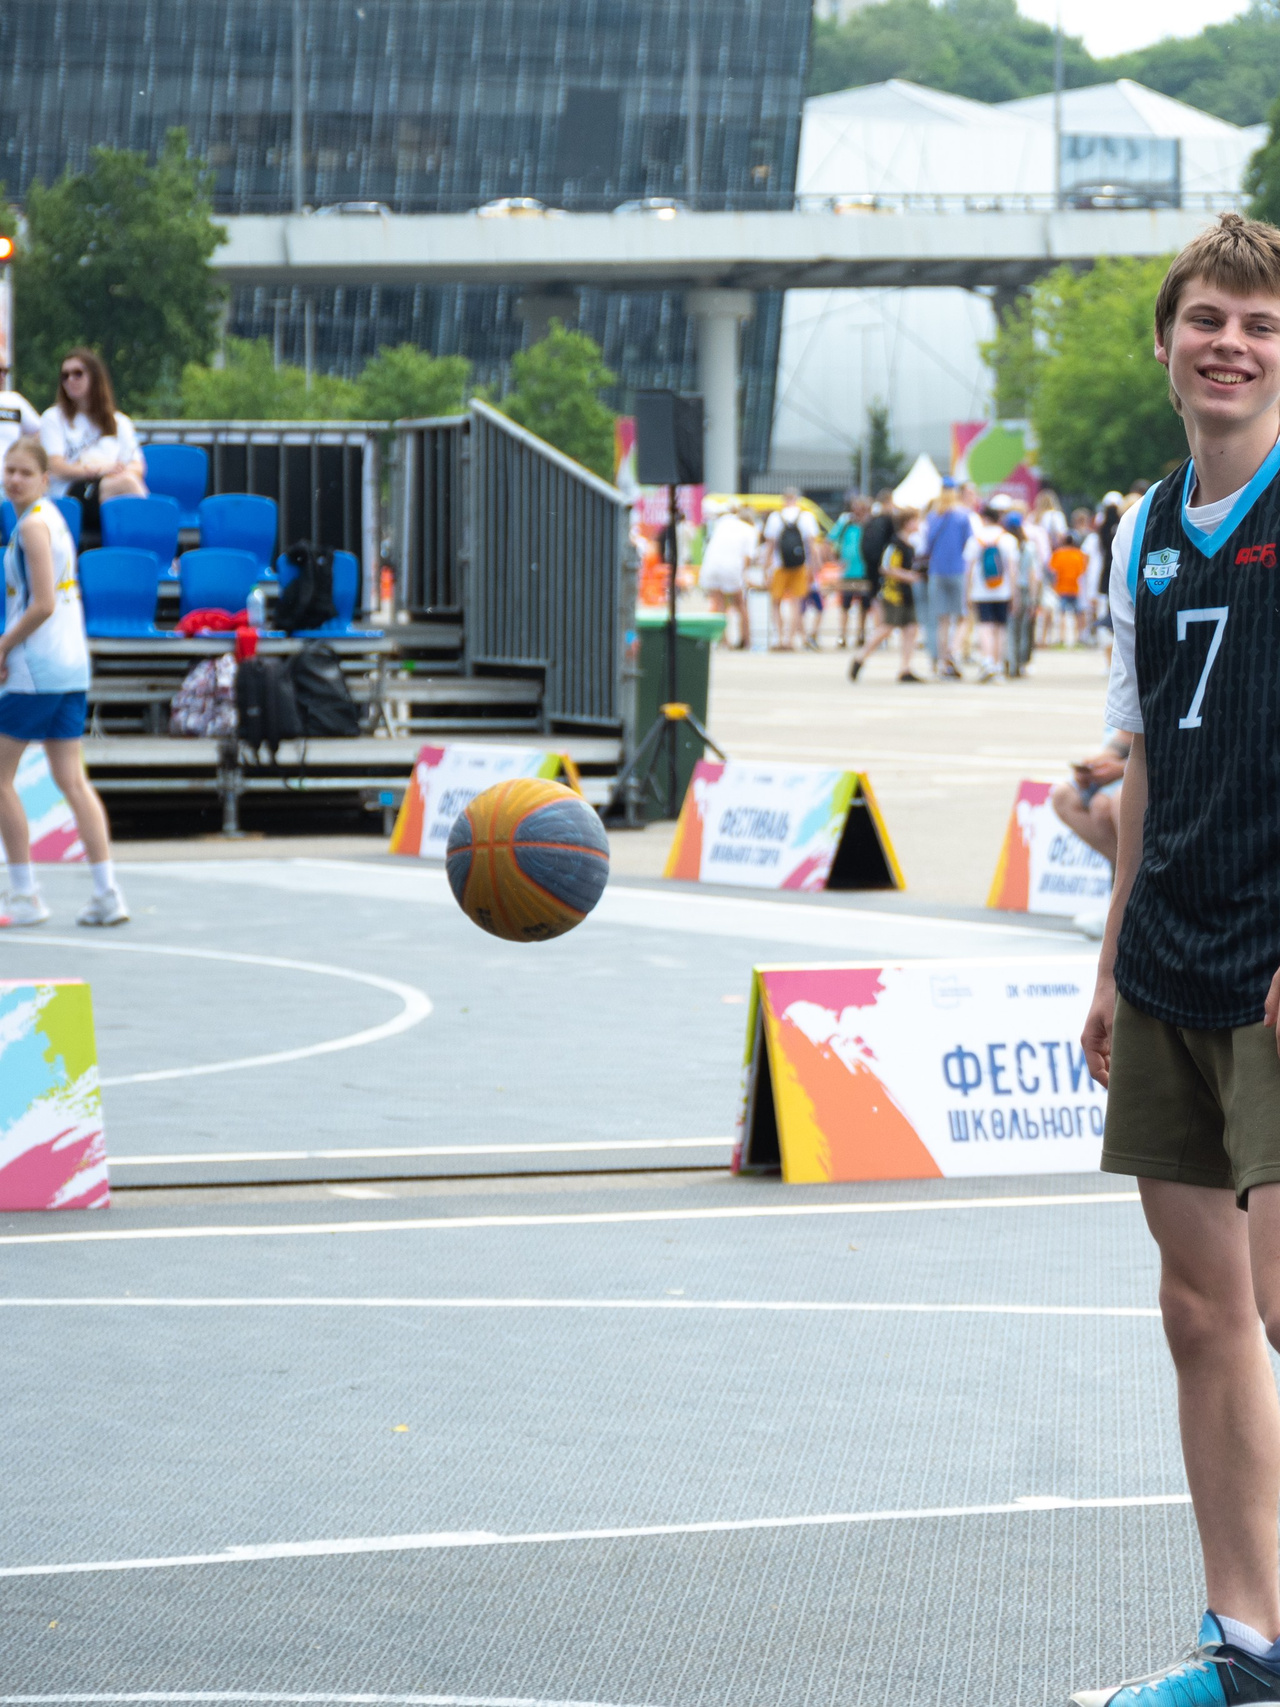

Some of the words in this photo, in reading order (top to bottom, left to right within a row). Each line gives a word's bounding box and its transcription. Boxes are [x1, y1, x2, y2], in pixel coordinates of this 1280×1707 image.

[1177, 605, 1229, 730] 7
[943, 1041, 1095, 1096] ФЕСТИ
[948, 1106, 1105, 1142] ШКОЛЬНОГО
